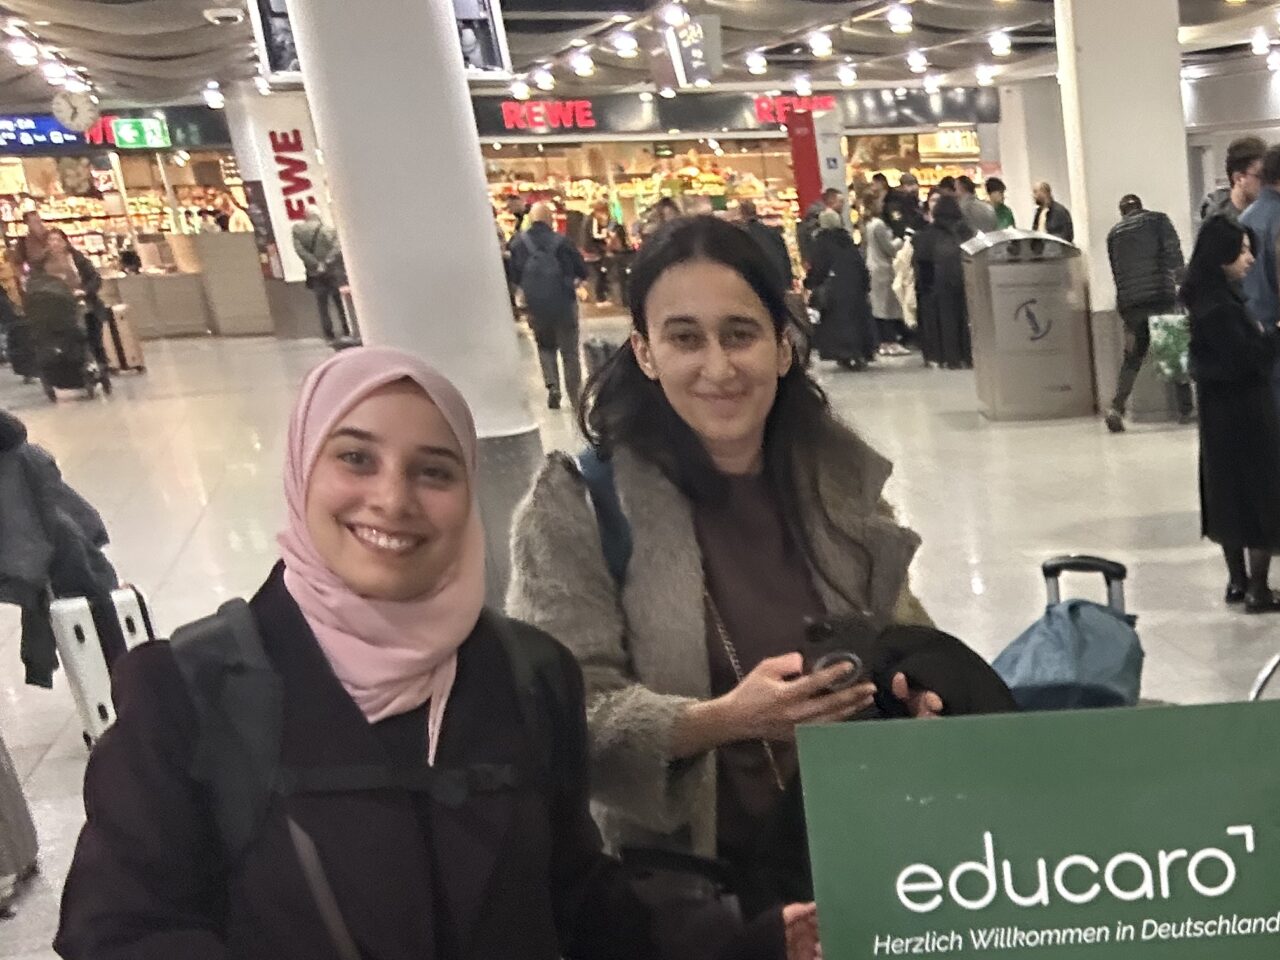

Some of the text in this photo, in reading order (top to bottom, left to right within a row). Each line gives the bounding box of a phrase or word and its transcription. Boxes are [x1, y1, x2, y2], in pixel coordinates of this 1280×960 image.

[501, 101, 597, 129] REWE
[268, 128, 317, 221] EWE
[895, 830, 1237, 913] educaro
[873, 929, 964, 956] Herzlich
[969, 924, 1111, 951] Willkommen
[1115, 919, 1136, 942] in
